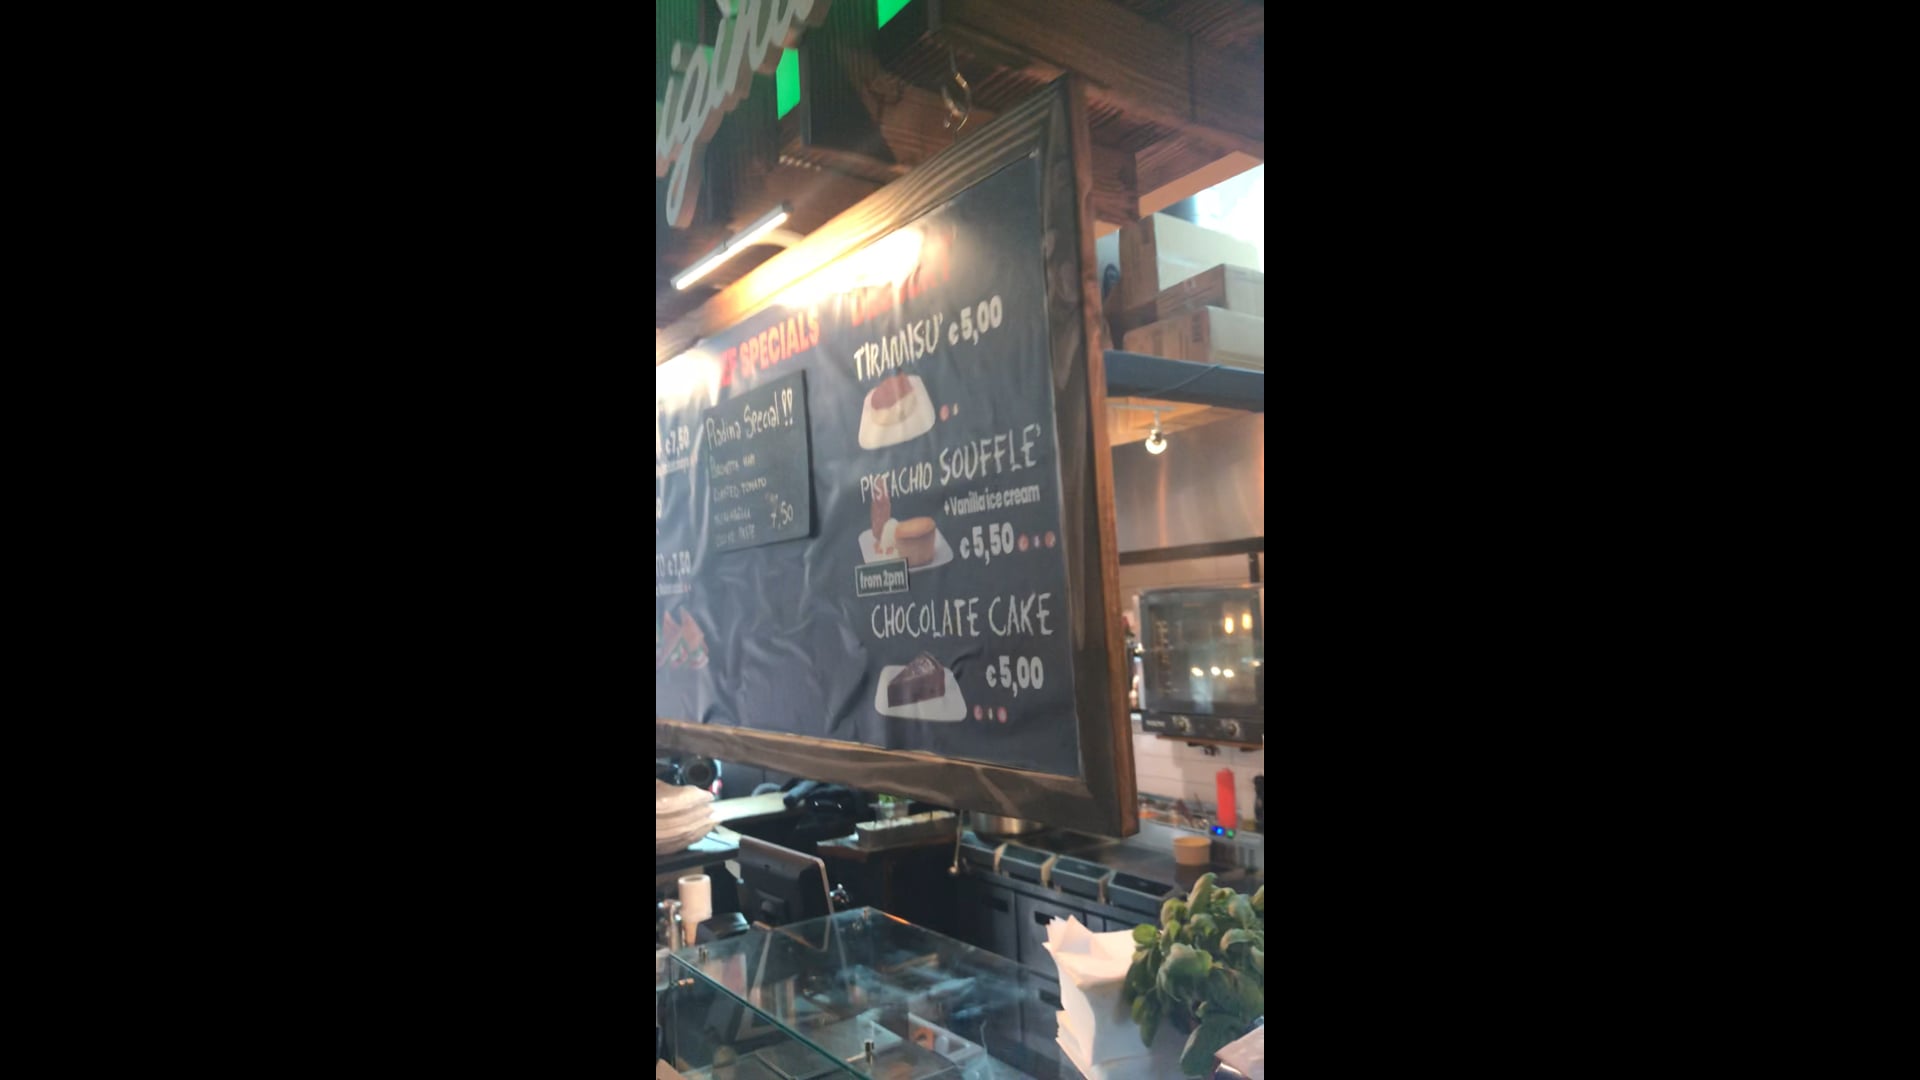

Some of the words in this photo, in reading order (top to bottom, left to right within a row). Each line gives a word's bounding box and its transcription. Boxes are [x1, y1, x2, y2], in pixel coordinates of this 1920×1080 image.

[739, 311, 820, 378] SPECIALS
[860, 462, 933, 503] PISTACHIO
[985, 488, 1003, 510] ice
[1003, 484, 1041, 506] cream
[859, 571, 882, 590] from
[882, 569, 905, 592] 2pm
[871, 597, 980, 639] CHOCOLATE
[988, 593, 1054, 636] CAKE
